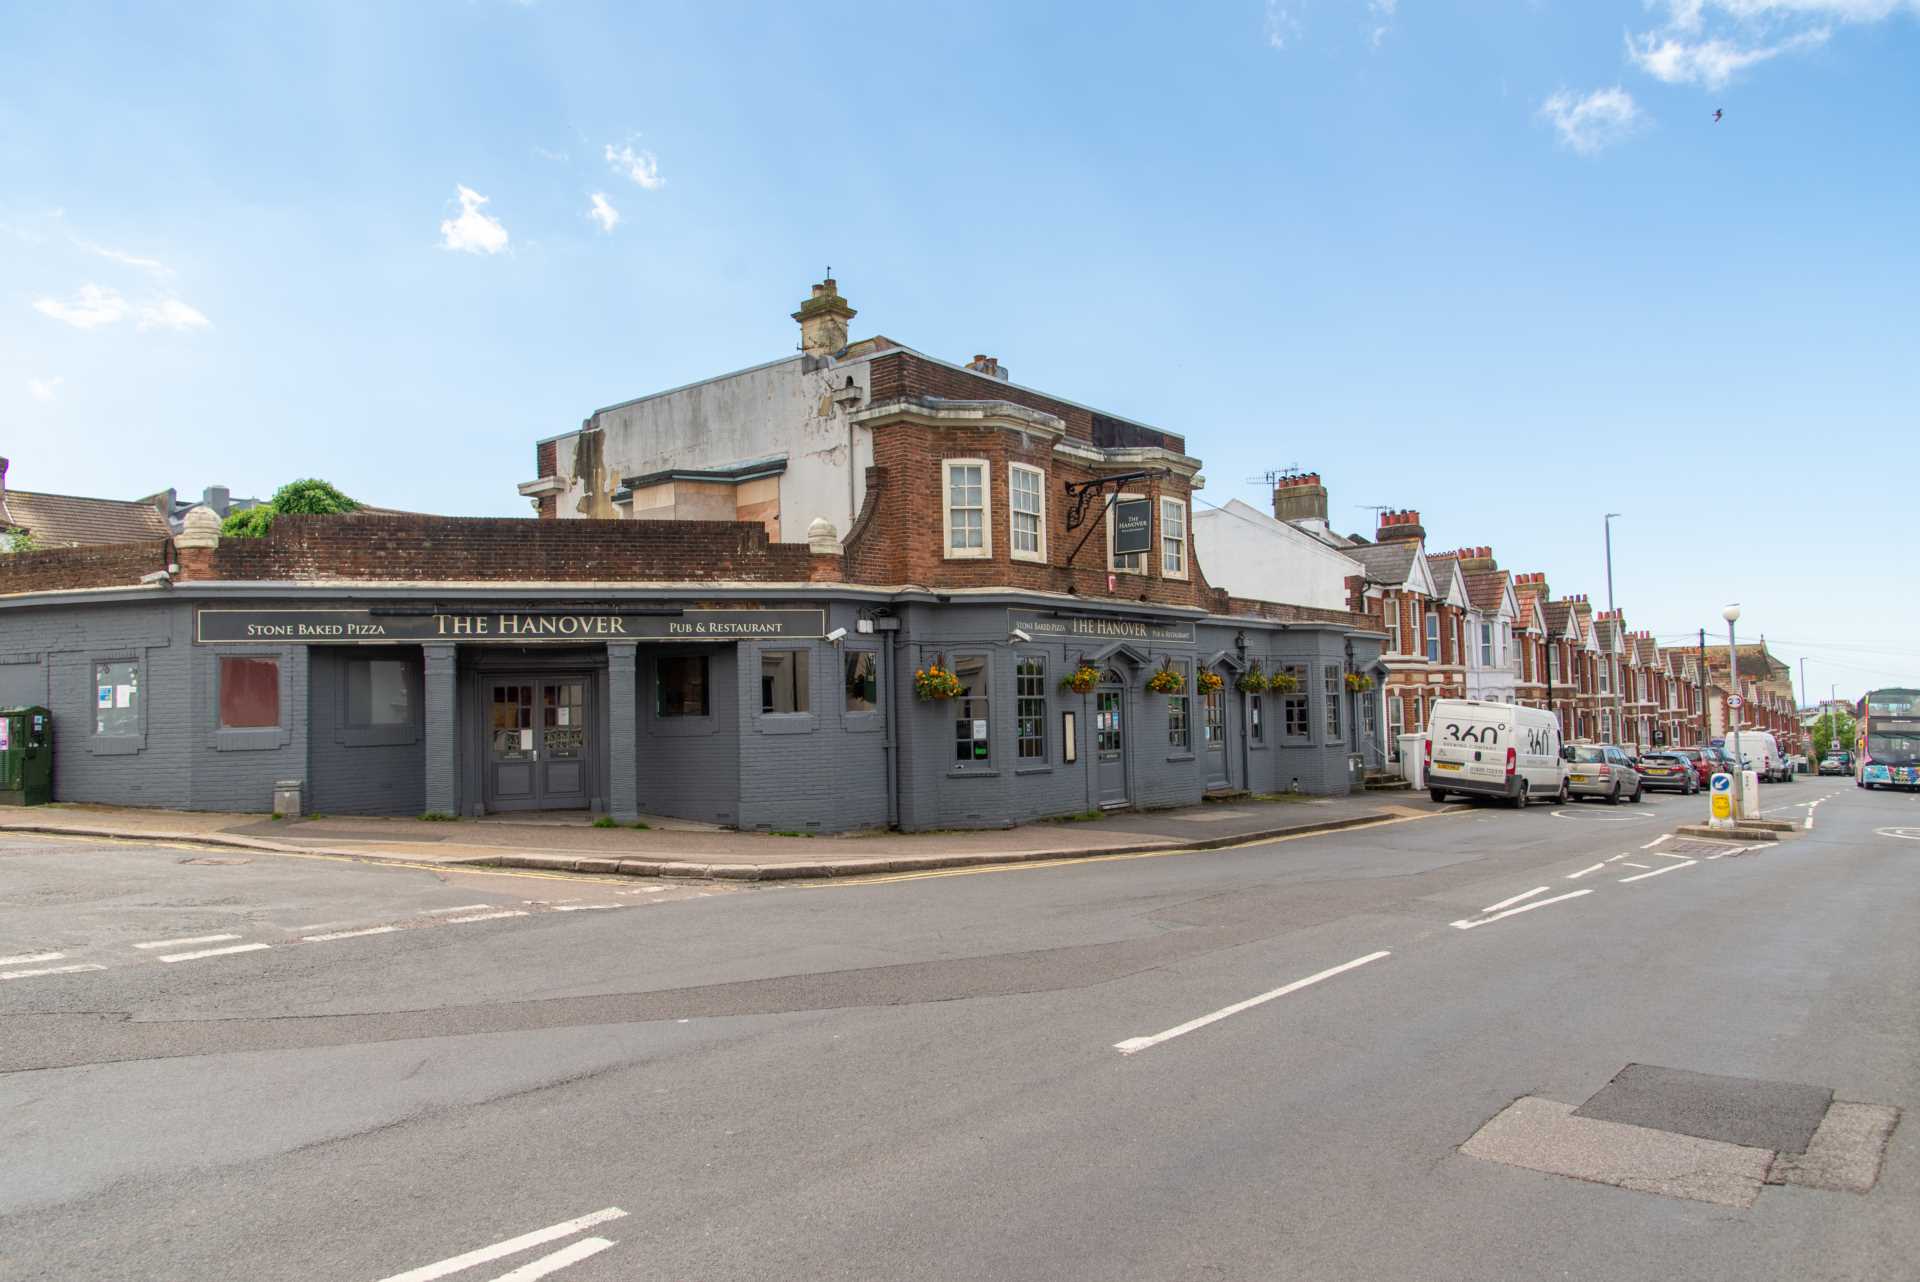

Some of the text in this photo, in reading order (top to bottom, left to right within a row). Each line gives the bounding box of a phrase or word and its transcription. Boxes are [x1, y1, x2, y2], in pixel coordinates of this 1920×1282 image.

[1119, 520, 1148, 529] HANOVER
[432, 614, 627, 634] THE HANOVER
[695, 622, 706, 633] &
[1072, 618, 1147, 637] THE HANOVER
